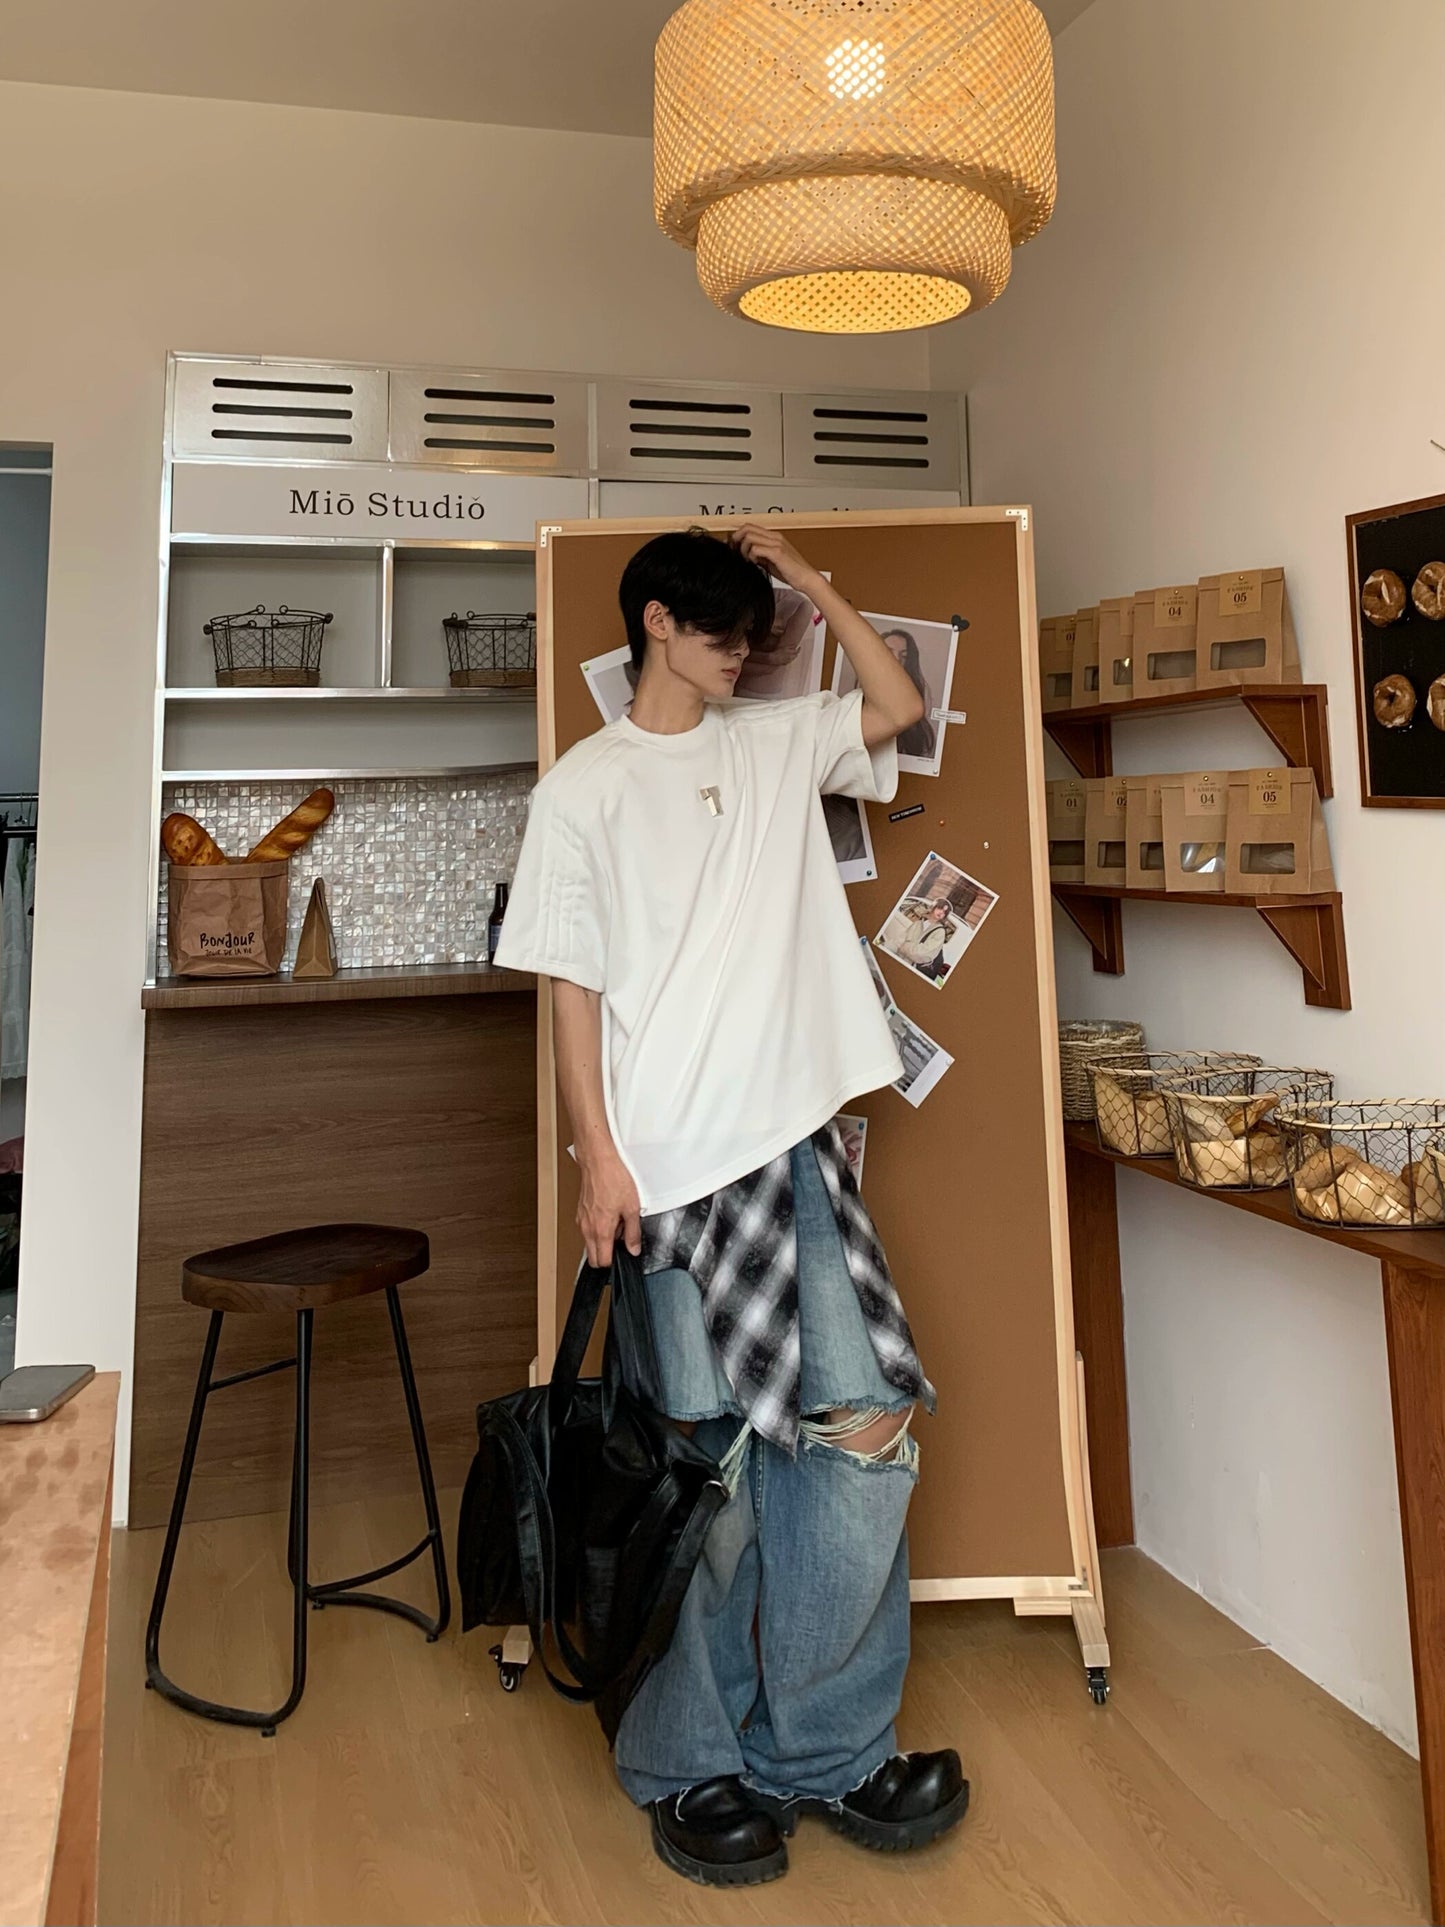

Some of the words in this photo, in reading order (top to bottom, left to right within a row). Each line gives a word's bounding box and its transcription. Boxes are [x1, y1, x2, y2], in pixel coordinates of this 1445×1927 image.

[1233, 592, 1247, 603] 05
[1168, 606, 1182, 616] 04
[1200, 793, 1215, 804] 04
[1263, 791, 1277, 803] 05
[1066, 798, 1078, 808] 01
[200, 931, 256, 949] BONJOUR
